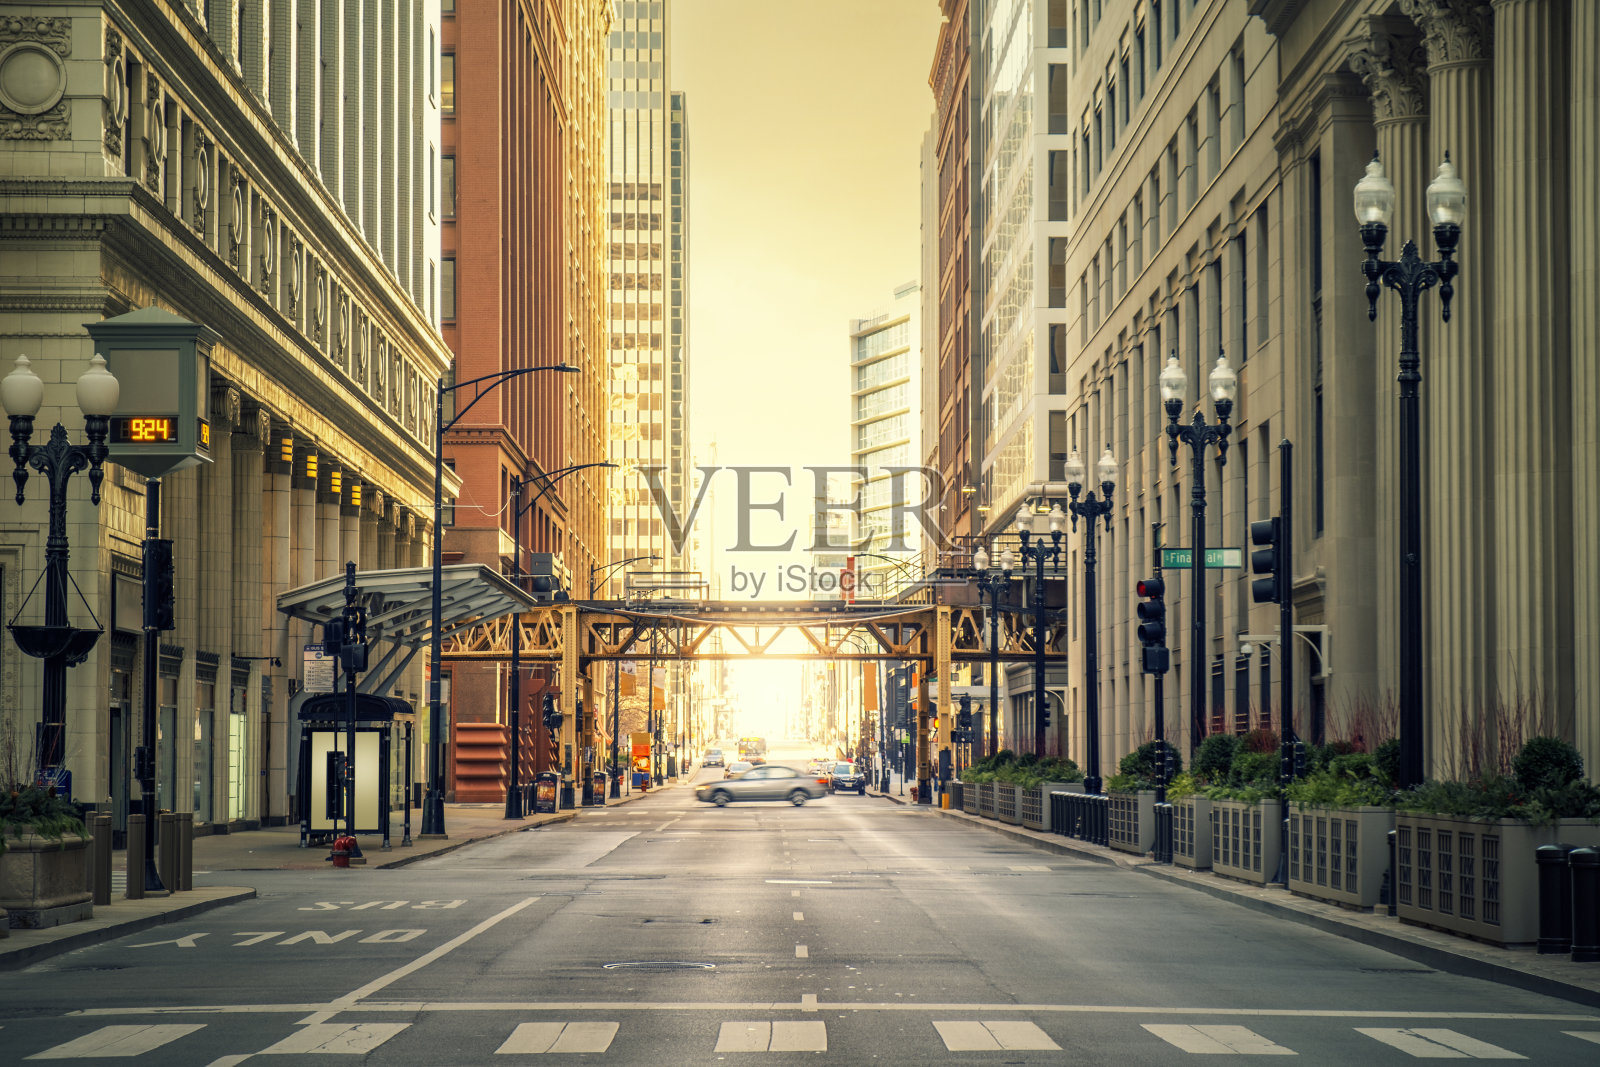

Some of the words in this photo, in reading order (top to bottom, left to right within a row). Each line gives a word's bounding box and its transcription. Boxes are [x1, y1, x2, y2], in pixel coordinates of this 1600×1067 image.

[131, 418, 169, 440] 9:24
[1170, 552, 1216, 563] Finaal
[125, 928, 428, 948] ONLY
